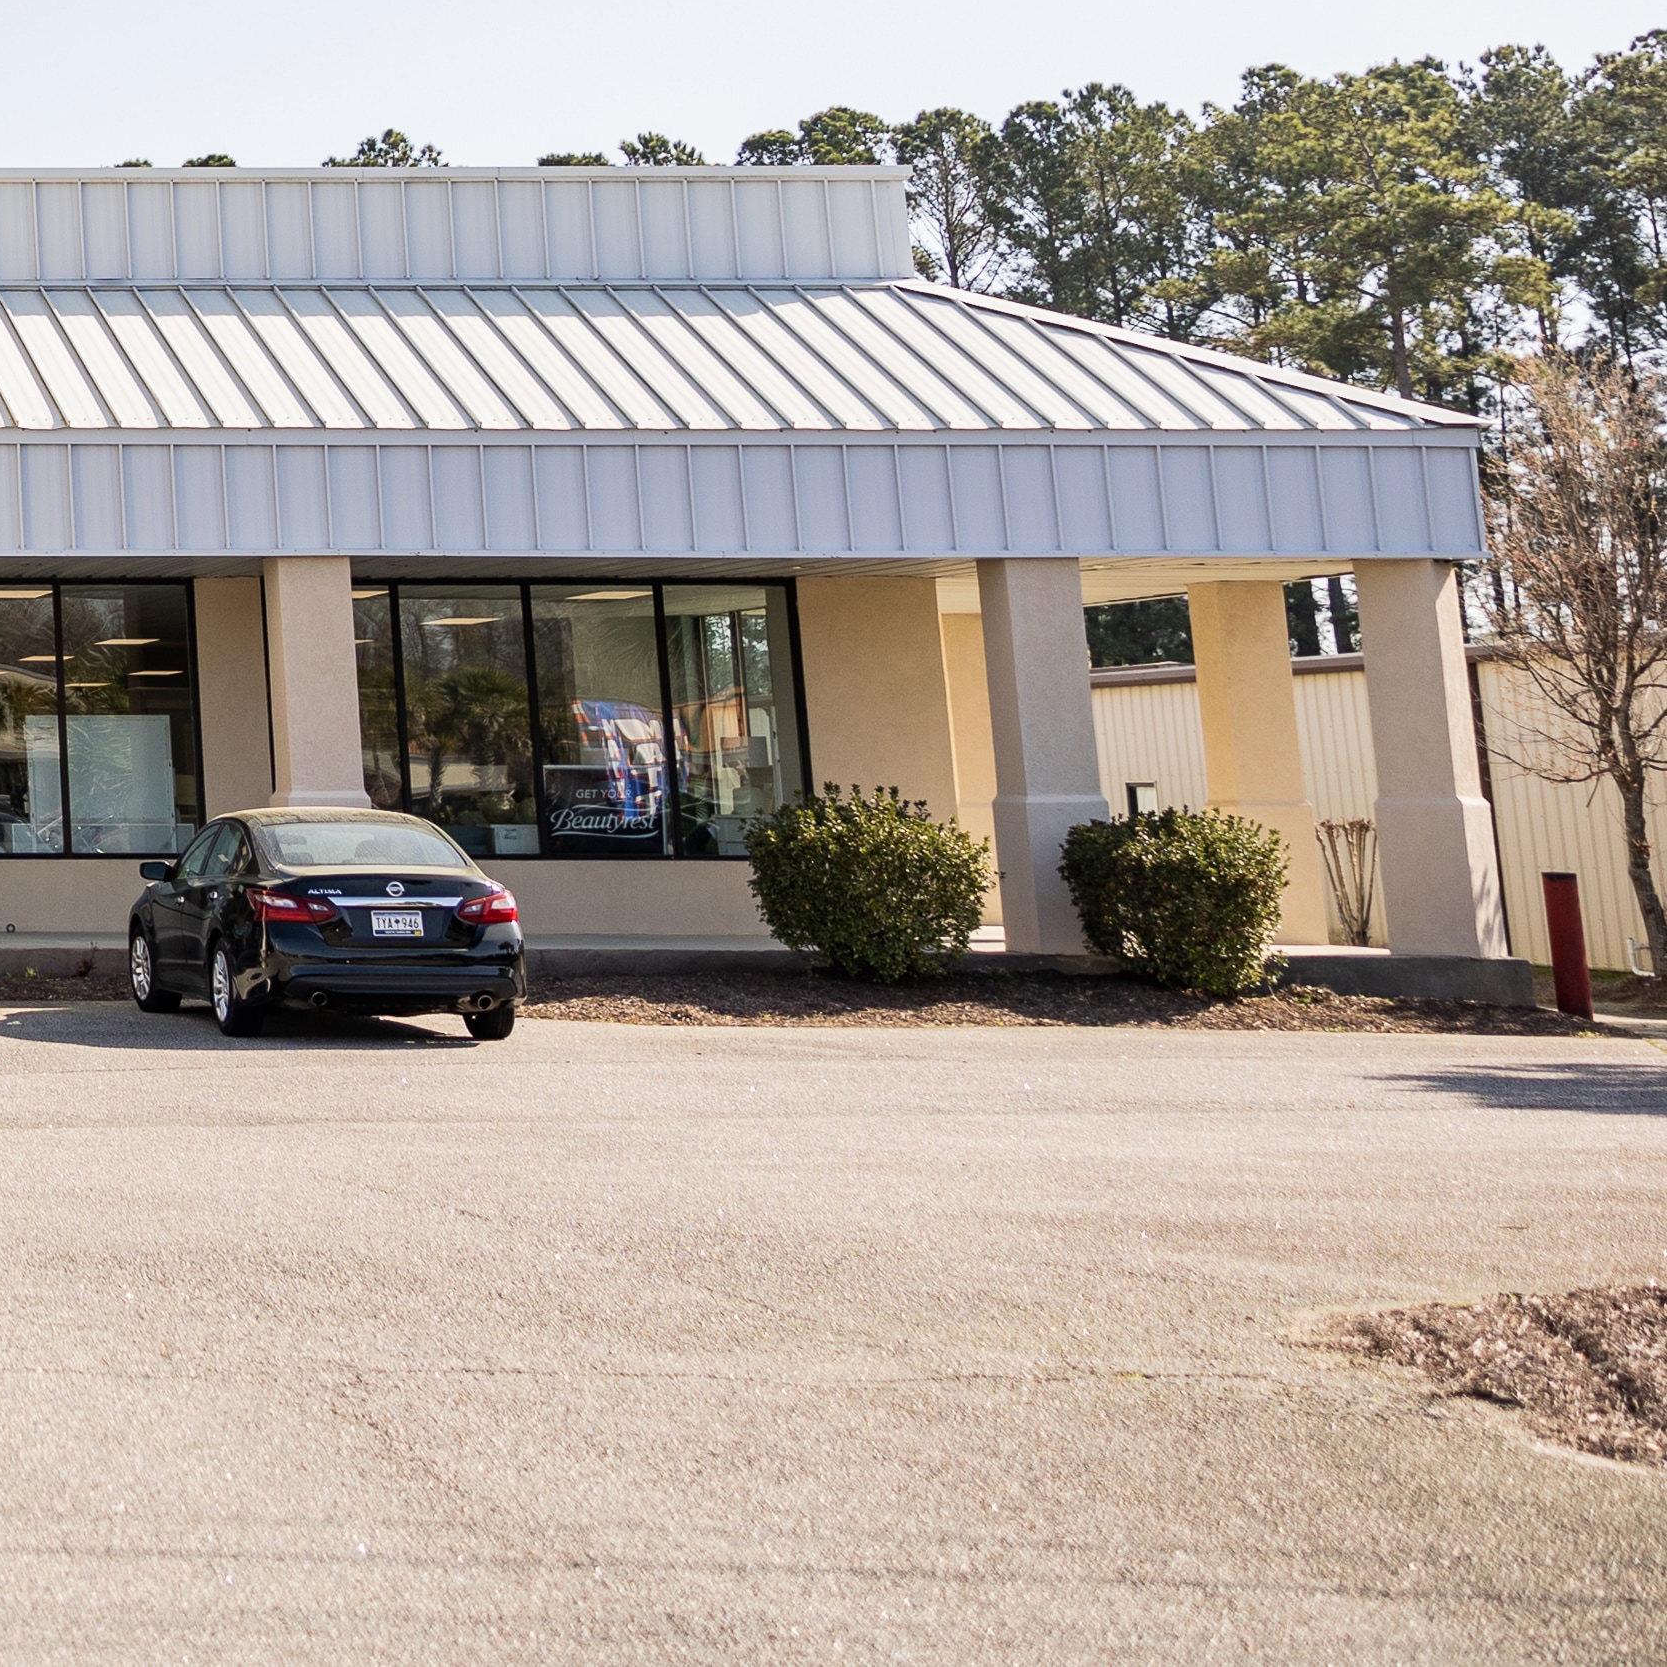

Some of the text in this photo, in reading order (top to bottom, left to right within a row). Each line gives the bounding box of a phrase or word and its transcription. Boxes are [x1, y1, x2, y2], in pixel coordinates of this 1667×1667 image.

[575, 789, 597, 799] GET
[550, 808, 658, 834] Beautyrest
[375, 917, 419, 929] TYA 946
